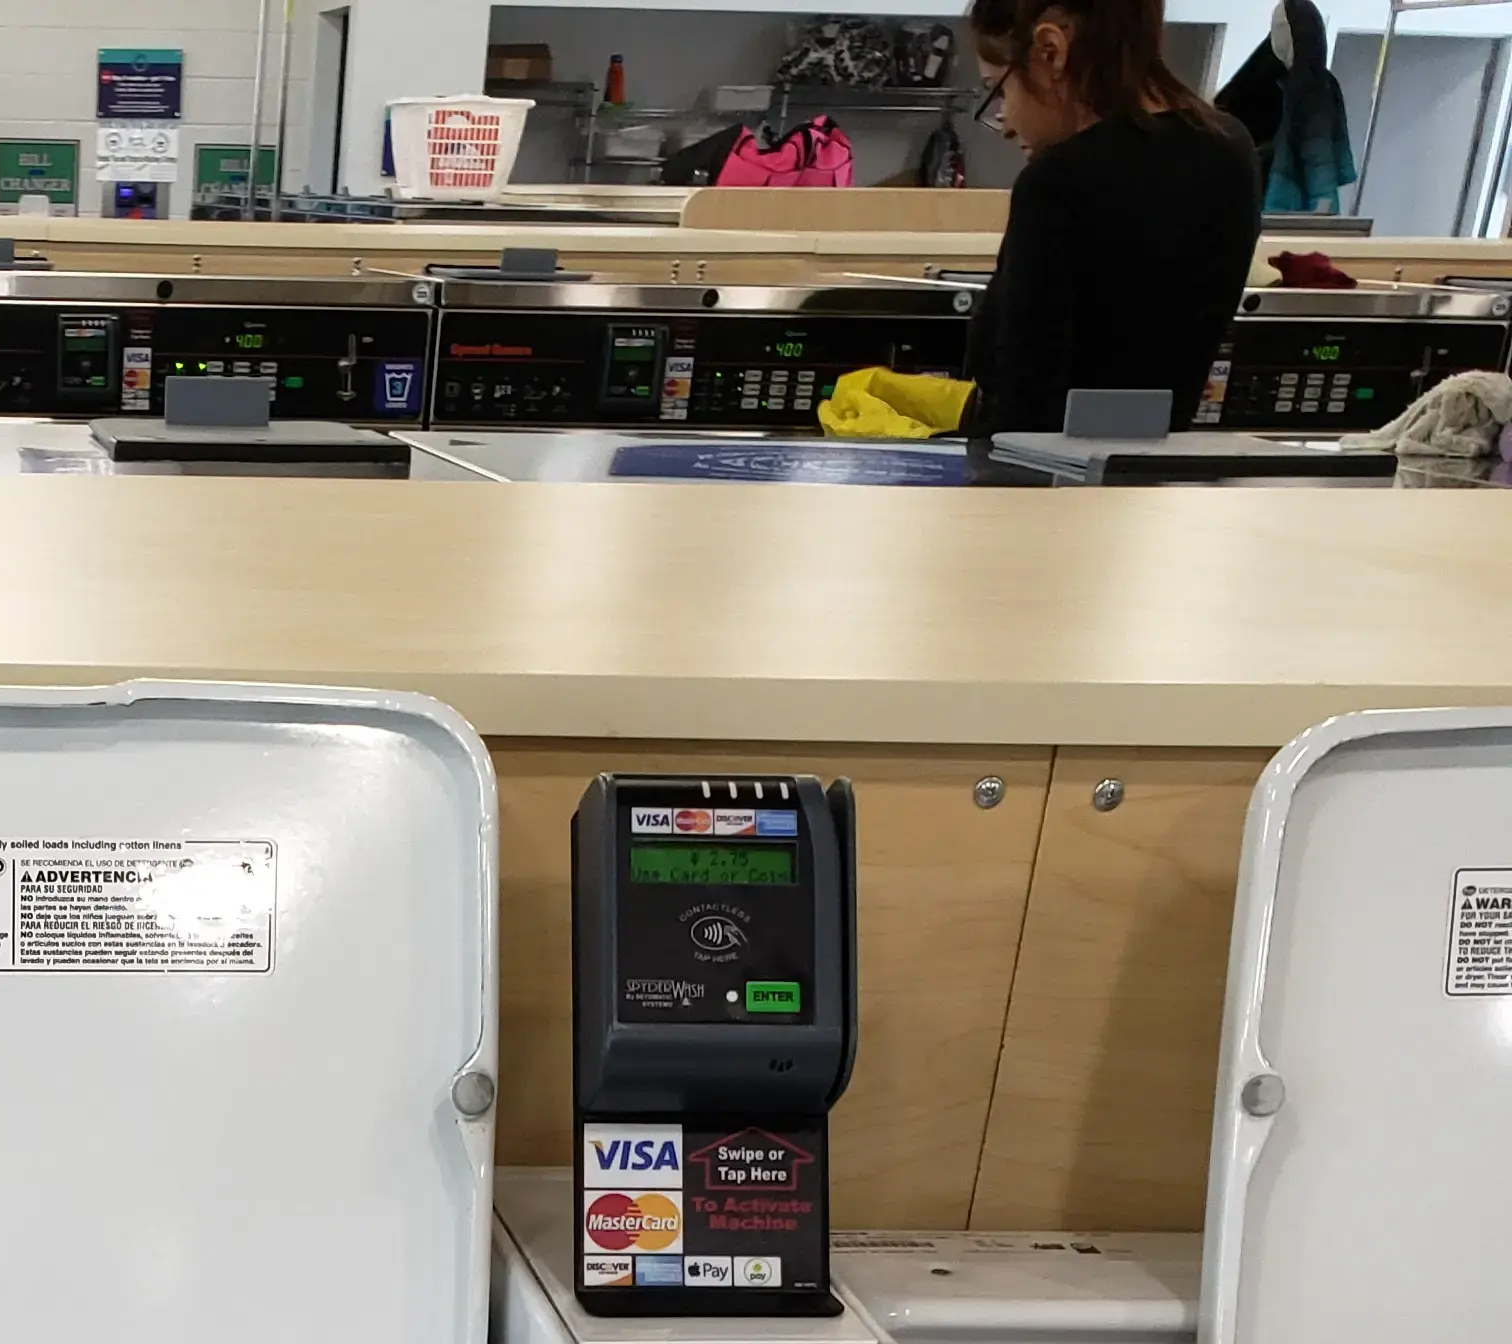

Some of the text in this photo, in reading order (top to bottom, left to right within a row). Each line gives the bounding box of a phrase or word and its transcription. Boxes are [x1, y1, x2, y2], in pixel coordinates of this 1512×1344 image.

[126, 353, 149, 362] VISA
[668, 363, 692, 373] VISA
[635, 813, 670, 827] VISA
[10, 840, 40, 849] soiled
[42, 840, 69, 849] loads
[71, 840, 117, 851] including
[153, 841, 182, 850] linens
[20, 884, 103, 894] PARA SU SEGURIDAD
[679, 903, 752, 924] CONTACTLESS
[753, 990, 794, 1003] ENTER
[588, 1140, 680, 1171] VISA
[718, 1145, 785, 1162] Swipe or
[717, 1167, 787, 1183] Tap Here
[692, 1196, 813, 1213] To Activate
[587, 1213, 680, 1233] MasterCard
[709, 1214, 798, 1231] Machine
[702, 1262, 729, 1281] Pay
[750, 1272, 766, 1282] pay
